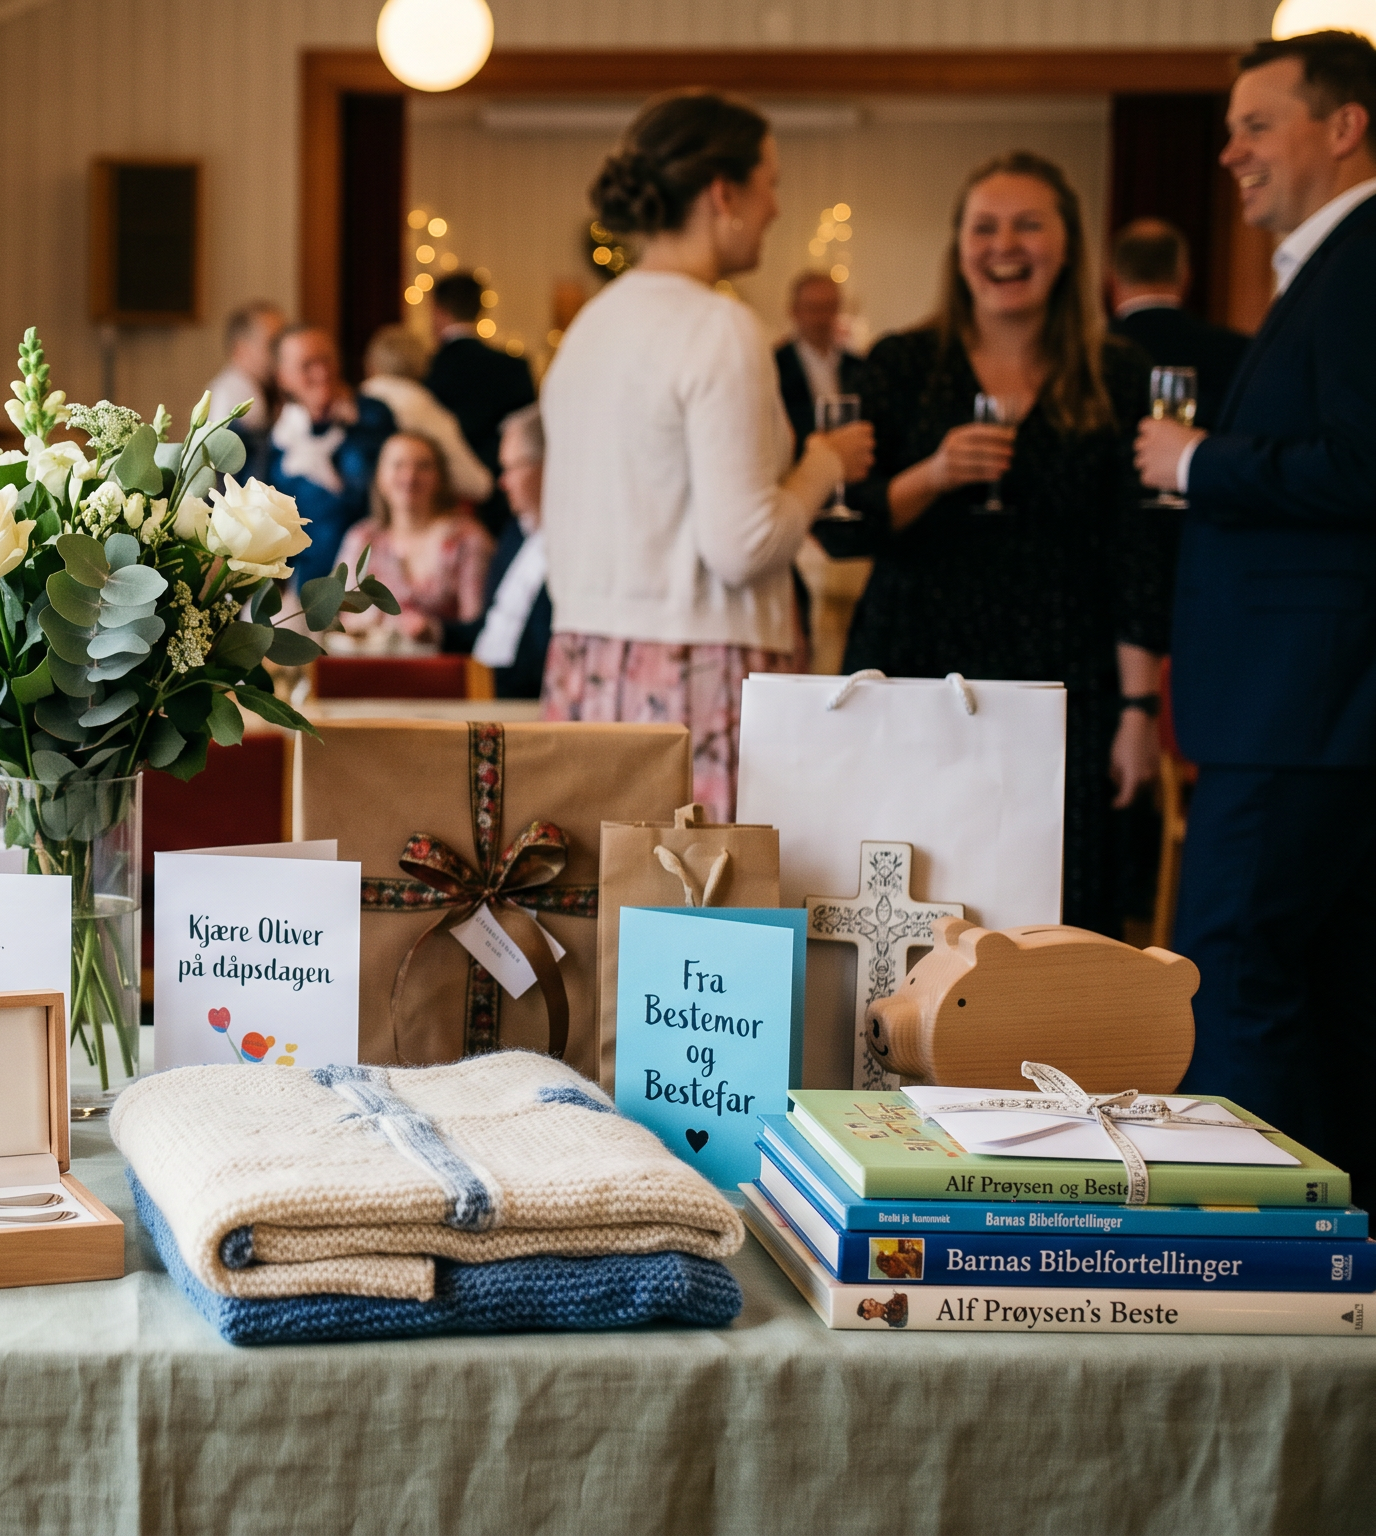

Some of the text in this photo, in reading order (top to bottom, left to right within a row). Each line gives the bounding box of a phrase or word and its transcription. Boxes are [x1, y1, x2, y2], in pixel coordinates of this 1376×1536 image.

[189, 913, 324, 949] Kjære Oliver
[178, 953, 335, 992] på dåpsdagen
[683, 959, 728, 995] Fra
[644, 993, 764, 1040] Bestemor
[686, 1044, 717, 1078] og
[644, 1068, 756, 1117] Bestefar
[944, 1175, 976, 1193] Alf
[980, 1176, 1054, 1199] Prøysen
[1059, 1183, 1079, 1200] og
[985, 1211, 1123, 1232] Barnas Bibelfortellinger
[946, 1248, 1243, 1283] Barnas Bibelfortellinger
[935, 1297, 1179, 1330] Alf Prøysen’s Beste
